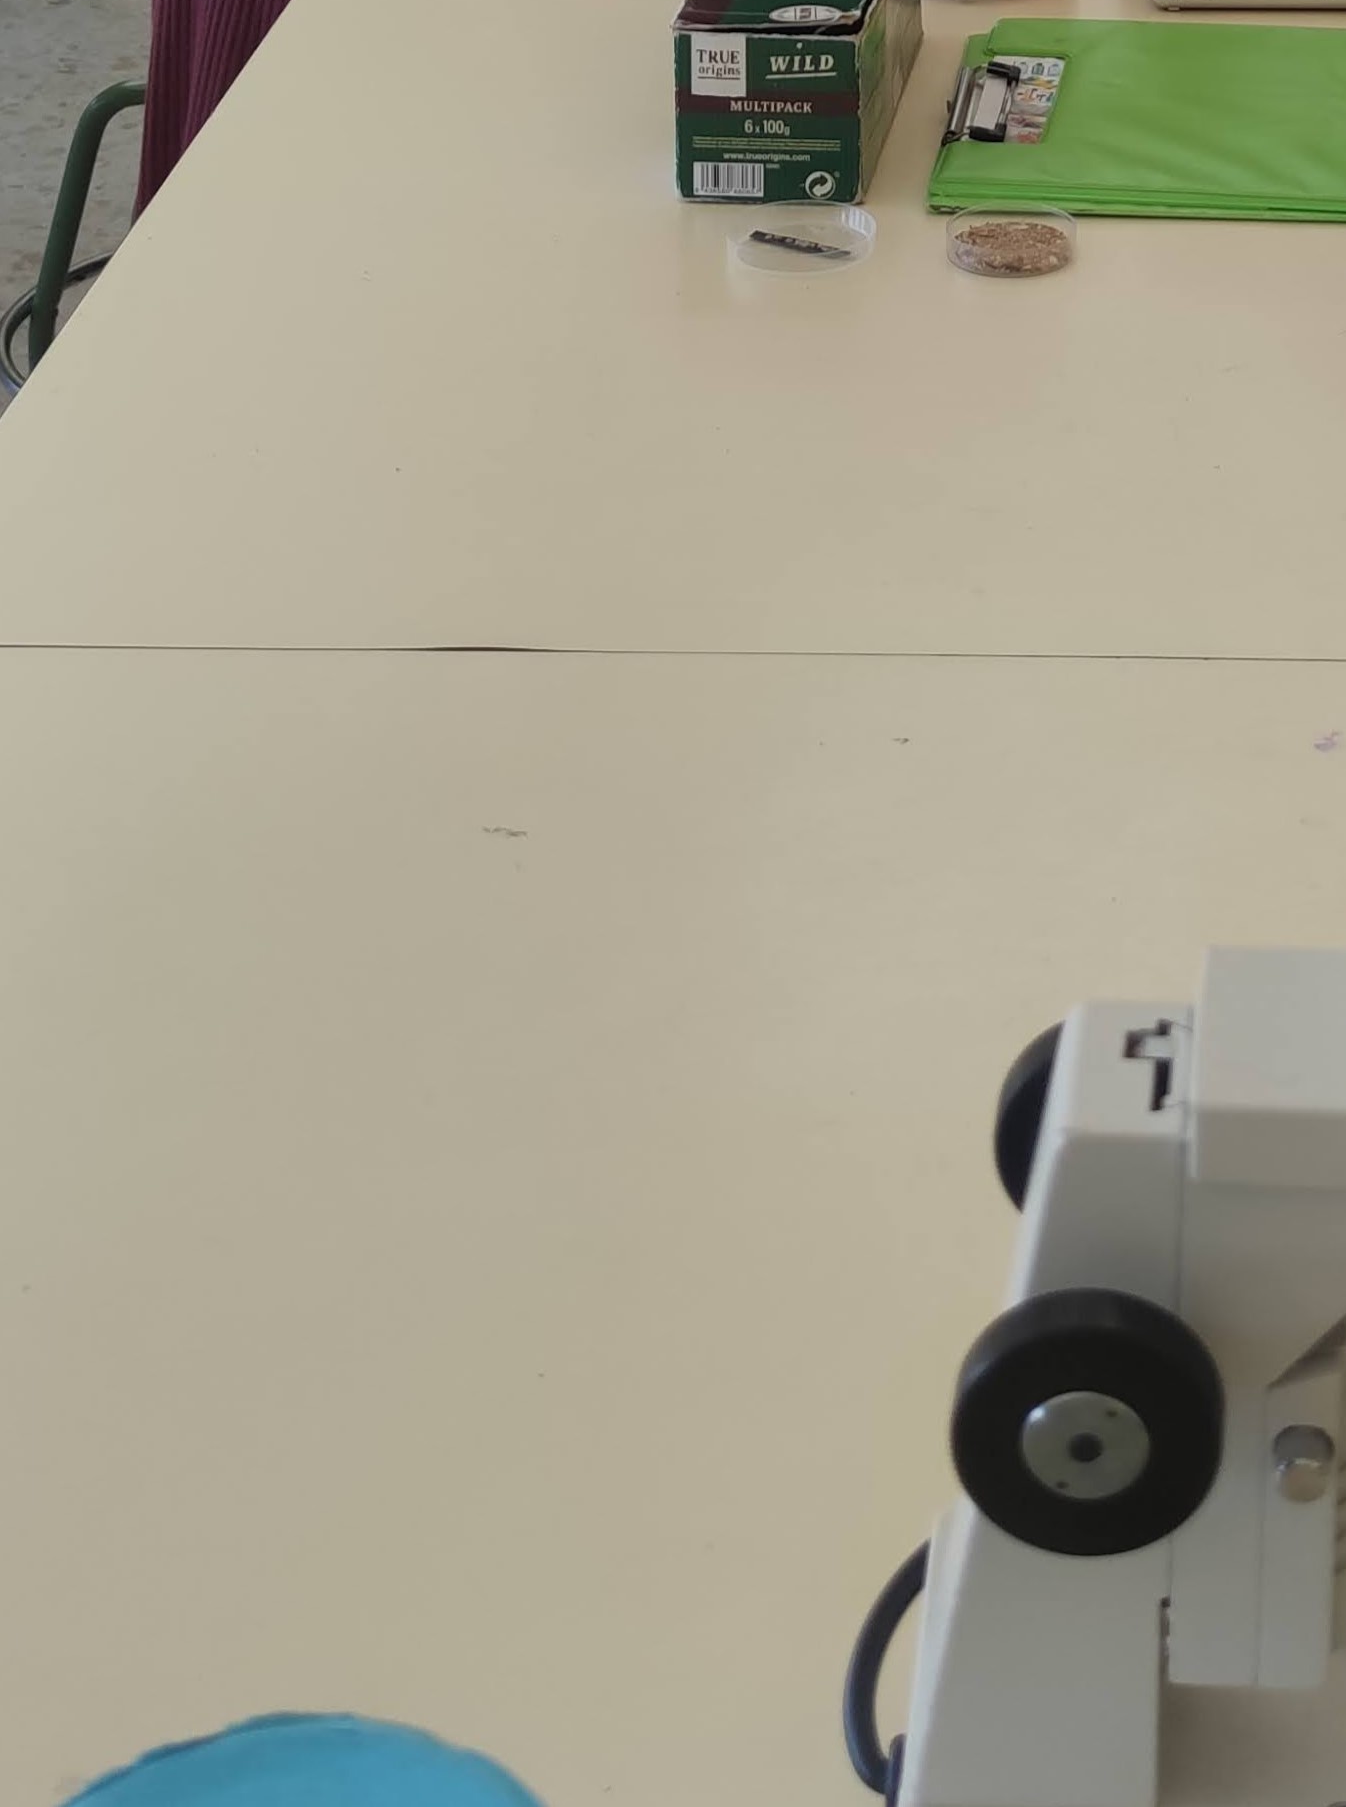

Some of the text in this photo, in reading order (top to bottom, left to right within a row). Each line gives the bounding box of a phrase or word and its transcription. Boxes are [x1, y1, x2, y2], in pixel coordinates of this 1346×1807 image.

[696, 49, 740, 65] TRUE
[769, 54, 835, 73] WILD
[698, 64, 741, 78] origins
[730, 99, 813, 114] MULTIPACK
[744, 119, 753, 134] 6
[763, 119, 791, 136] 100g
